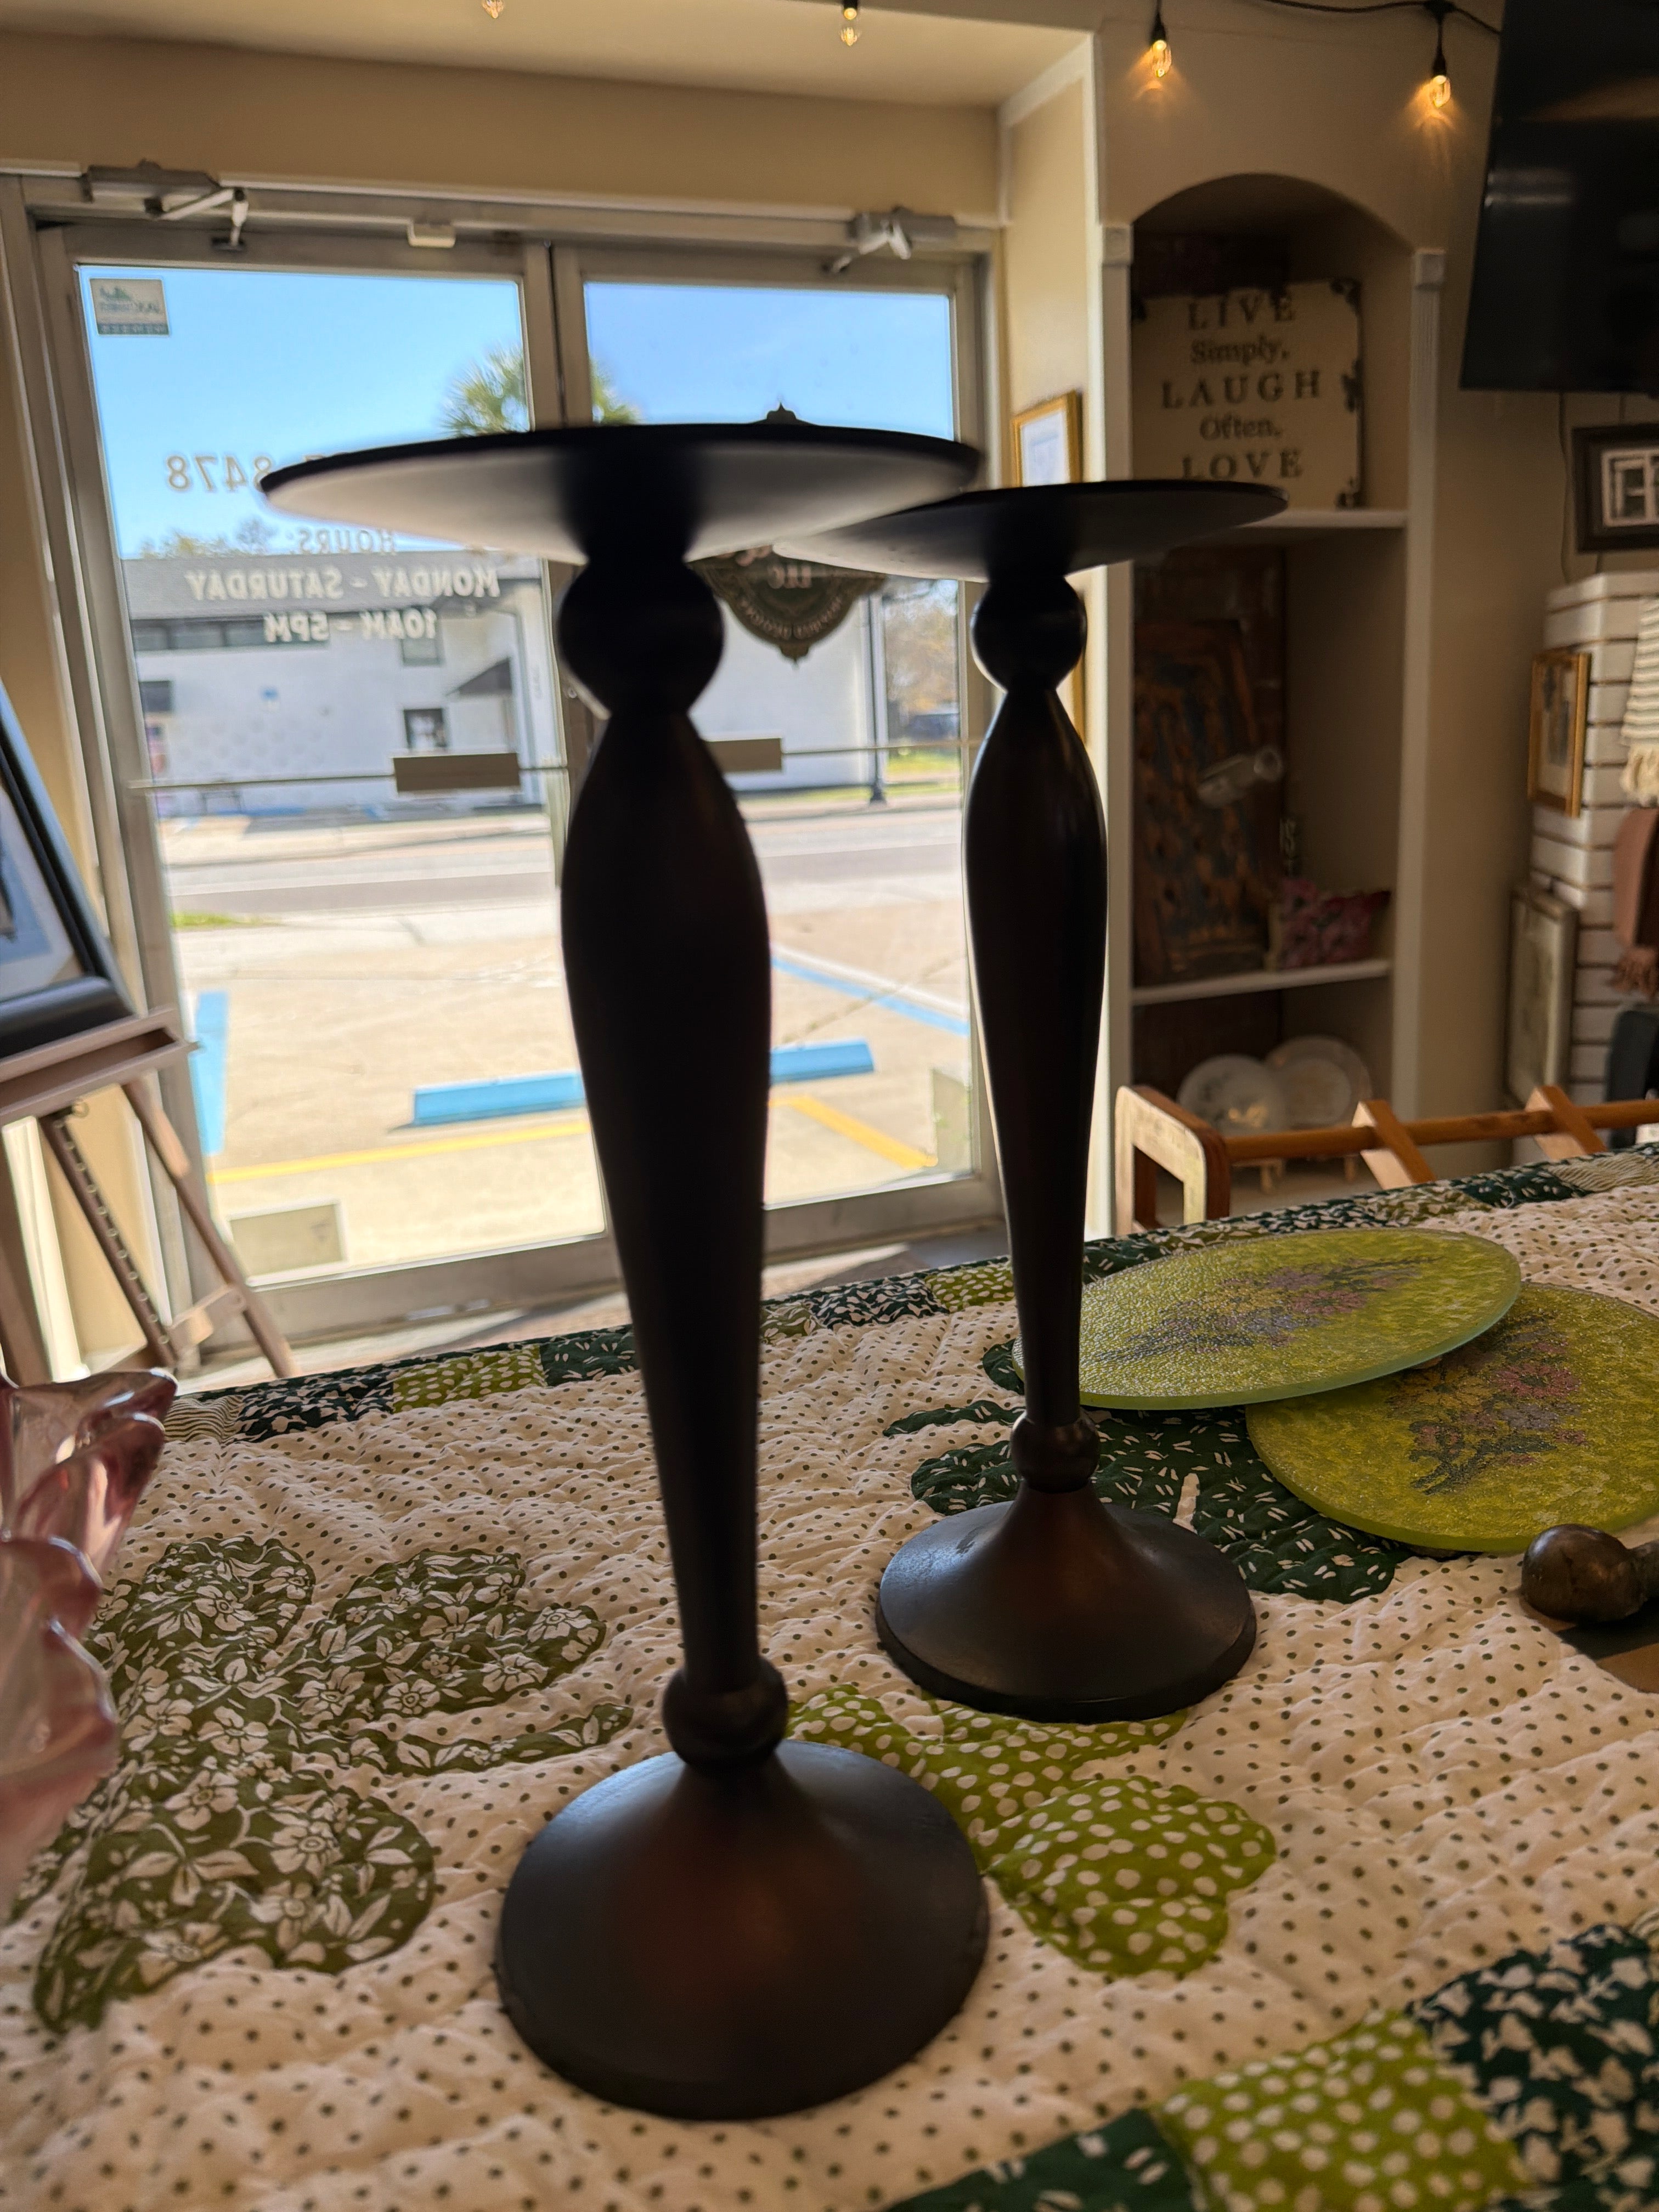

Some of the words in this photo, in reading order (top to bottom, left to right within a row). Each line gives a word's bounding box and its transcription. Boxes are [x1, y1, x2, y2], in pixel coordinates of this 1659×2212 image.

[1188, 292, 1296, 330] LIVE
[1161, 371, 1321, 409] LAUGH
[1181, 449, 1302, 480] LOVE
